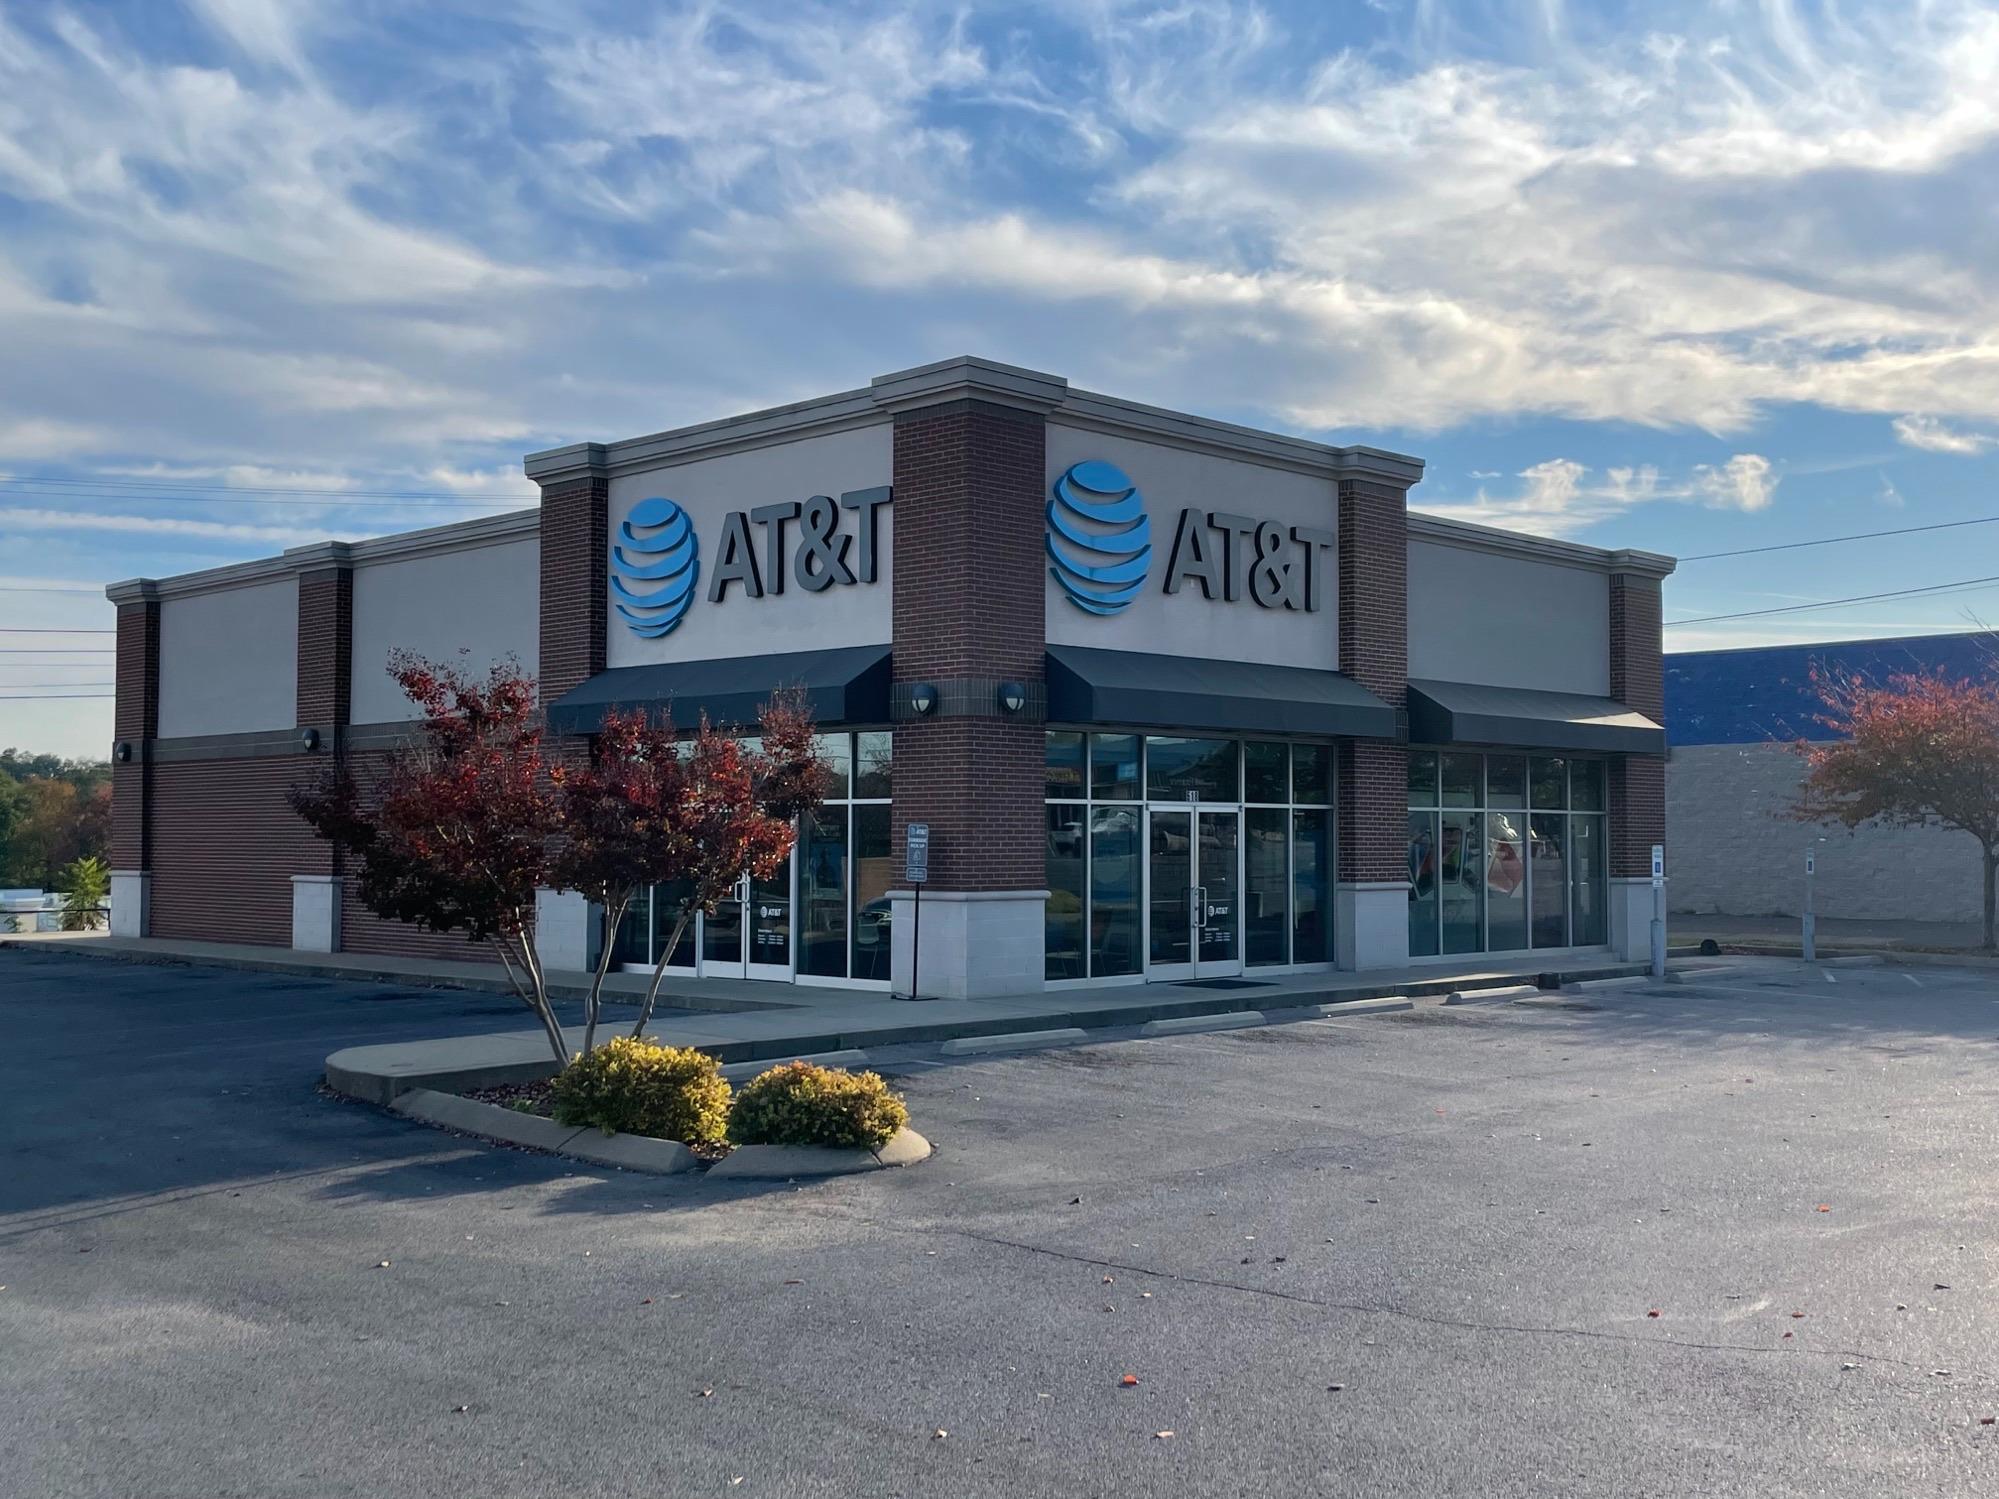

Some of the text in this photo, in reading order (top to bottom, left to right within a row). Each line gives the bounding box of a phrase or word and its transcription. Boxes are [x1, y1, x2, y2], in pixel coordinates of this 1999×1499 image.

[708, 486, 893, 603] AT&T
[1163, 508, 1334, 612] AT&T
[768, 908, 782, 917] AT&T
[1215, 907, 1229, 915] AT&T
